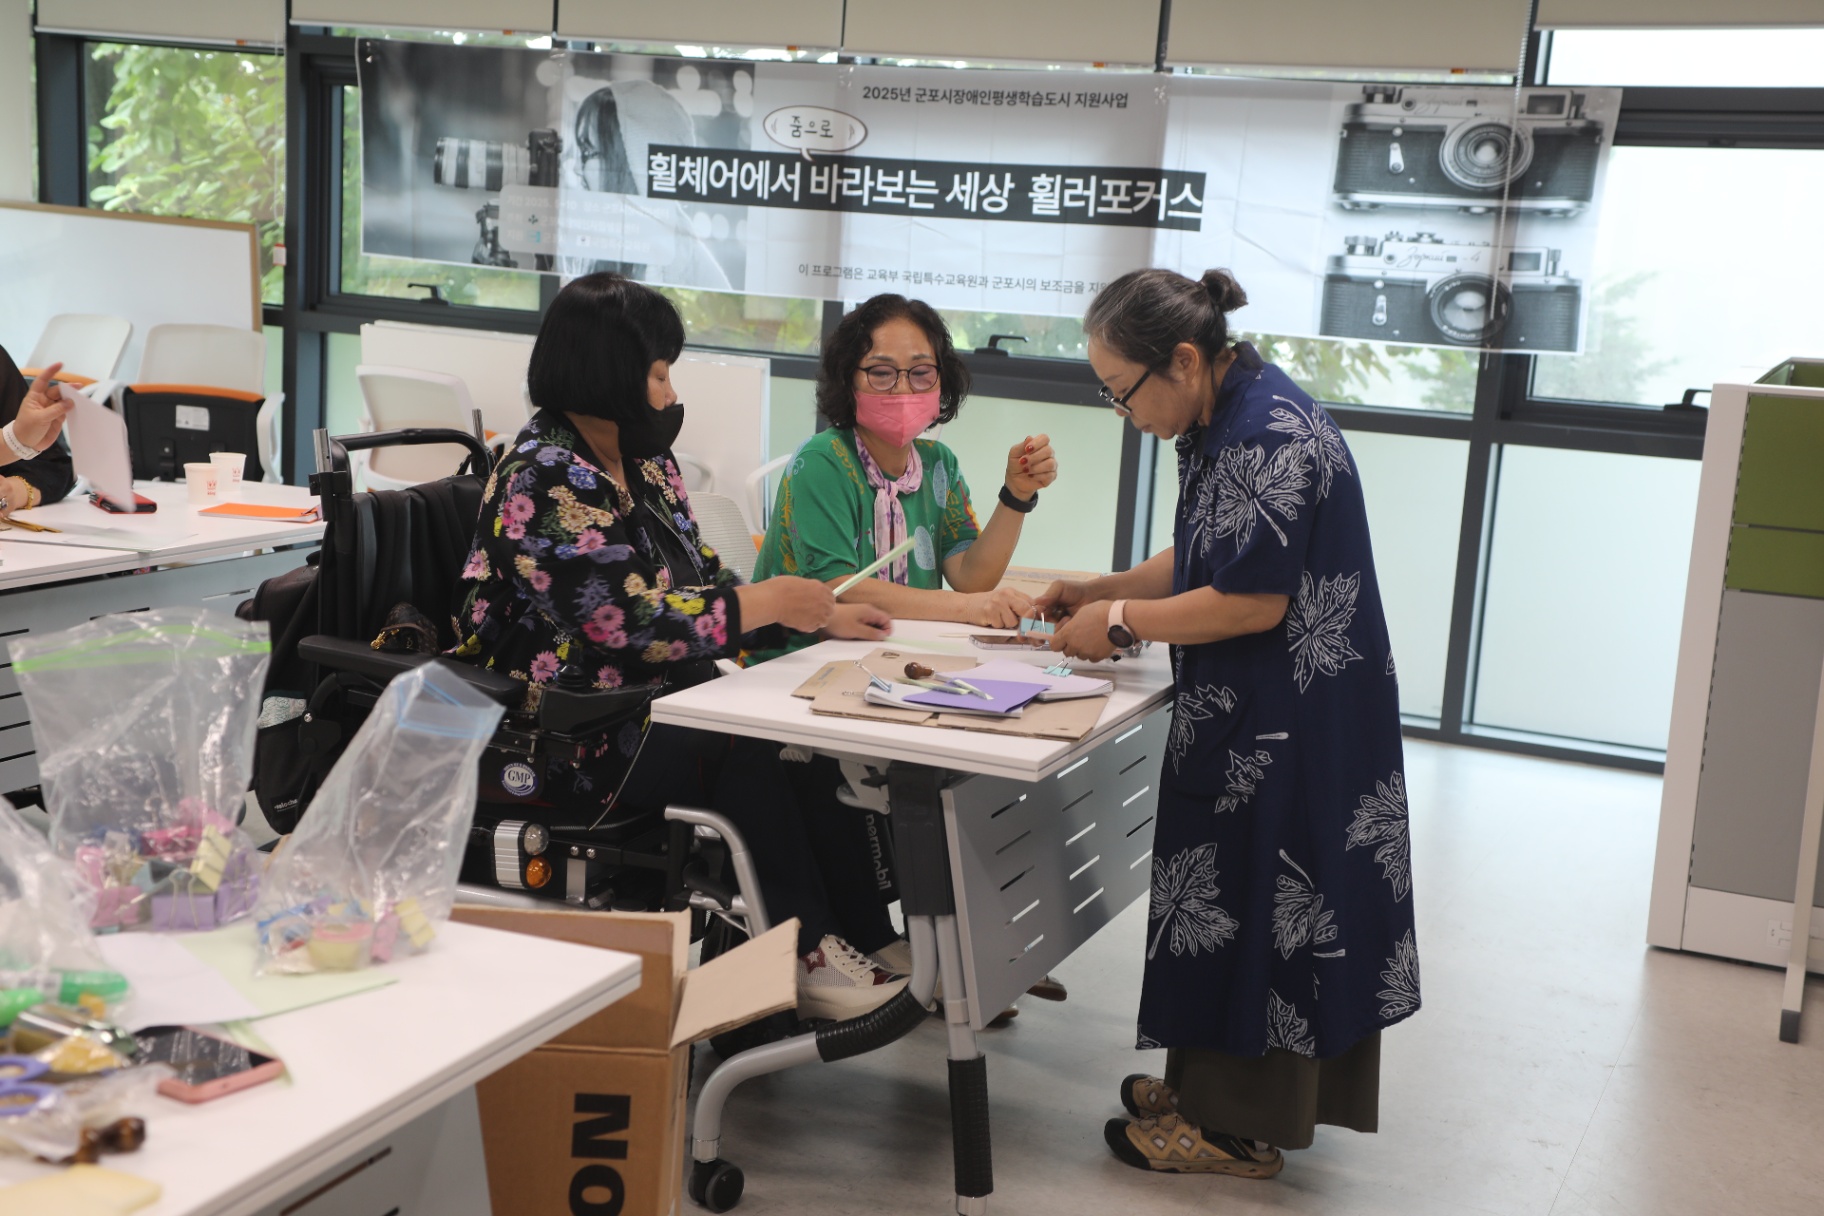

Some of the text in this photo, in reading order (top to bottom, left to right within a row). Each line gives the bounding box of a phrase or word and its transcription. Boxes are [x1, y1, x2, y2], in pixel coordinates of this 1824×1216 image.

[862, 86, 1128, 109] 2025년 군포시장애인평생학습도시 지원사업
[790, 115, 833, 138] 줌으로
[649, 152, 1203, 221] 휠체어에서 바라보는 세상 휠러포커스
[798, 263, 808, 276] 이
[811, 265, 864, 280] 프로그램은
[867, 268, 898, 282] 교육부
[902, 270, 989, 288] 국립특수교육원과
[992, 276, 1036, 291] 군포시의
[1040, 279, 1085, 294] 보조금을
[507, 769, 531, 784] GMP
